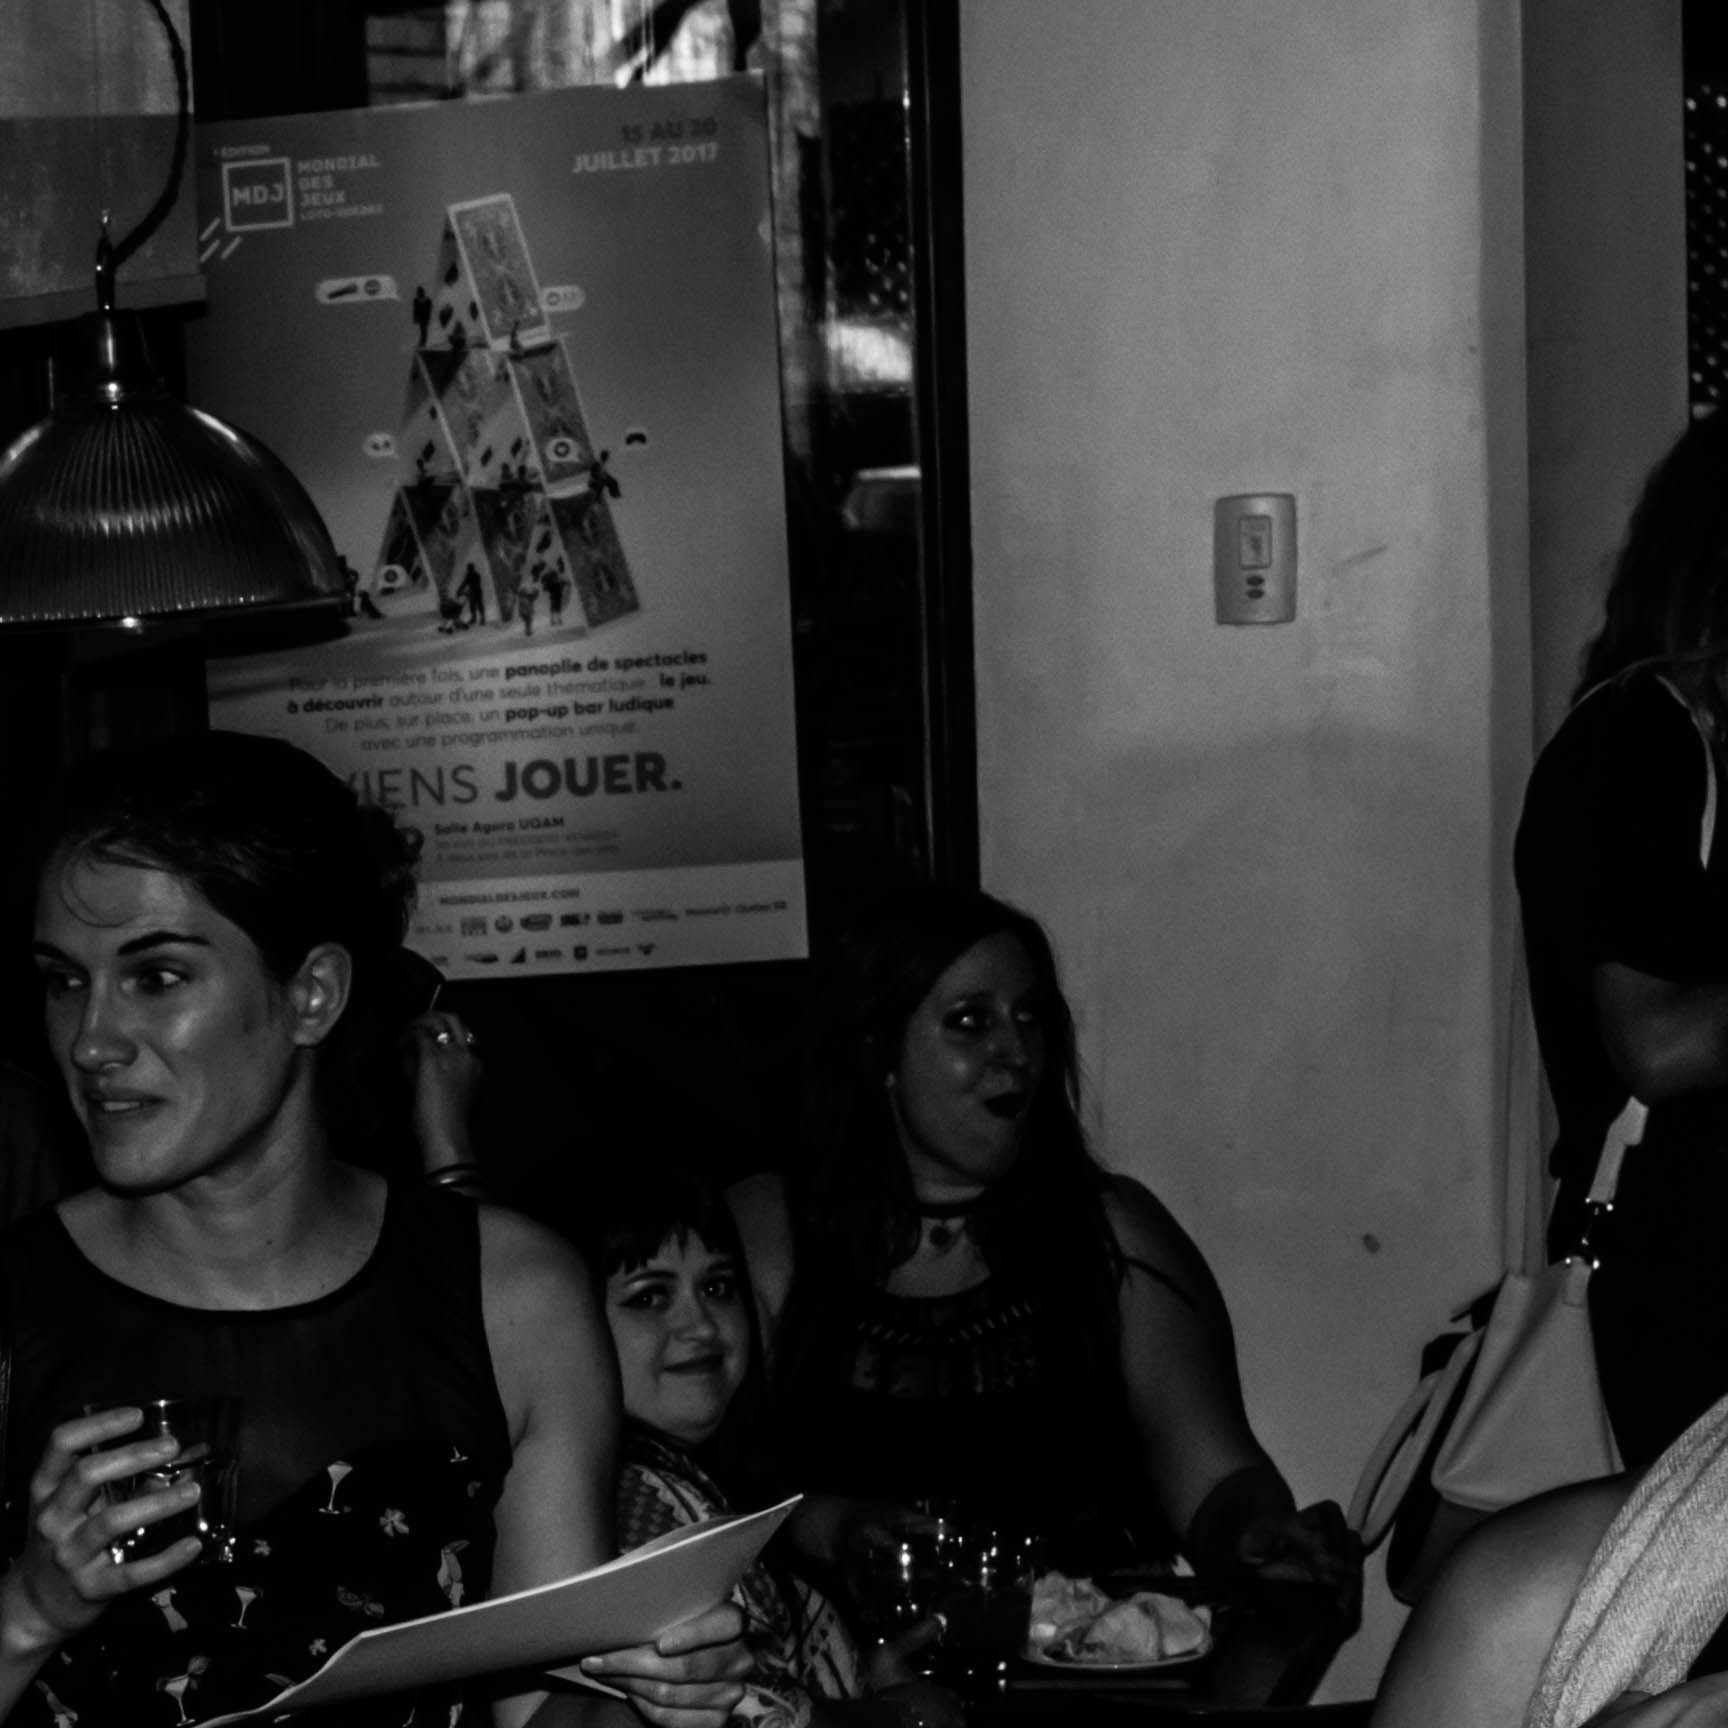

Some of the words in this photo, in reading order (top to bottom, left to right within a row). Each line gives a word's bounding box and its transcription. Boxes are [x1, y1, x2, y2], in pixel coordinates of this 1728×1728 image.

[571, 146, 663, 174] JUILLET
[667, 140, 720, 164] 2017
[504, 657, 581, 681] panoplie
[587, 654, 610, 673] de
[614, 648, 707, 674] spectacles
[302, 692, 384, 715] découvrir
[659, 671, 676, 690] le
[505, 703, 569, 726] pop-up
[574, 698, 604, 716] bar
[608, 693, 675, 719] ludique
[495, 752, 683, 803] JOUER.
